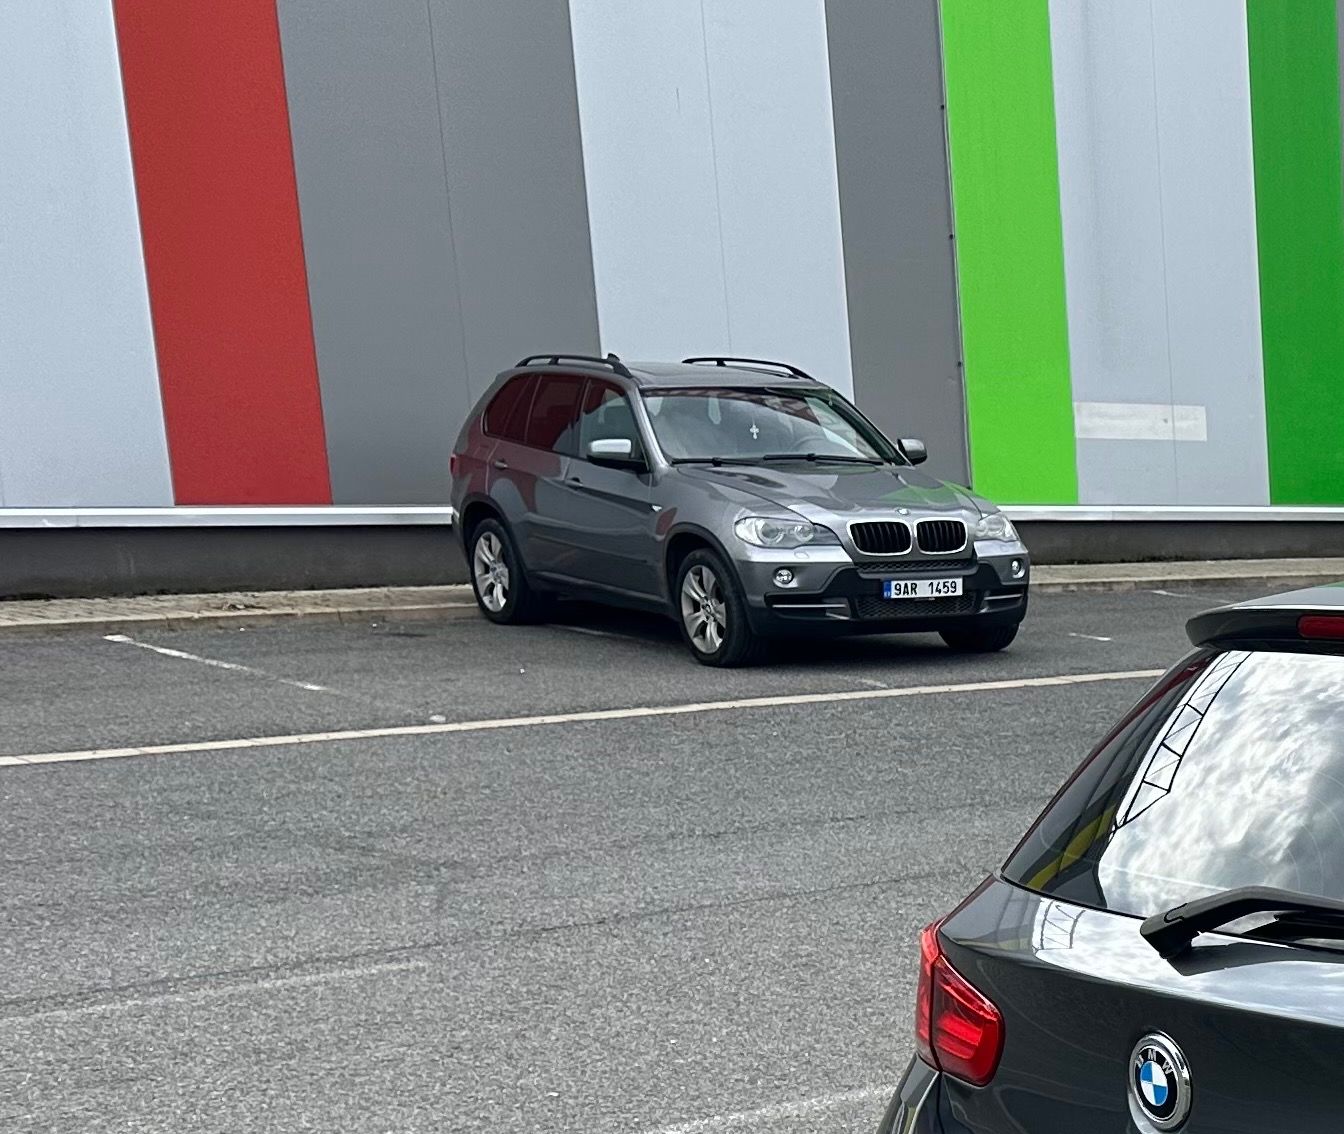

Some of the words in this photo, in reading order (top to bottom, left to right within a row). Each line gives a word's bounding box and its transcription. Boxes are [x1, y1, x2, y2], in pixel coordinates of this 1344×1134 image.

[894, 582, 918, 596] 9AR
[928, 580, 957, 595] 1459
[1135, 1048, 1174, 1075] BMW
